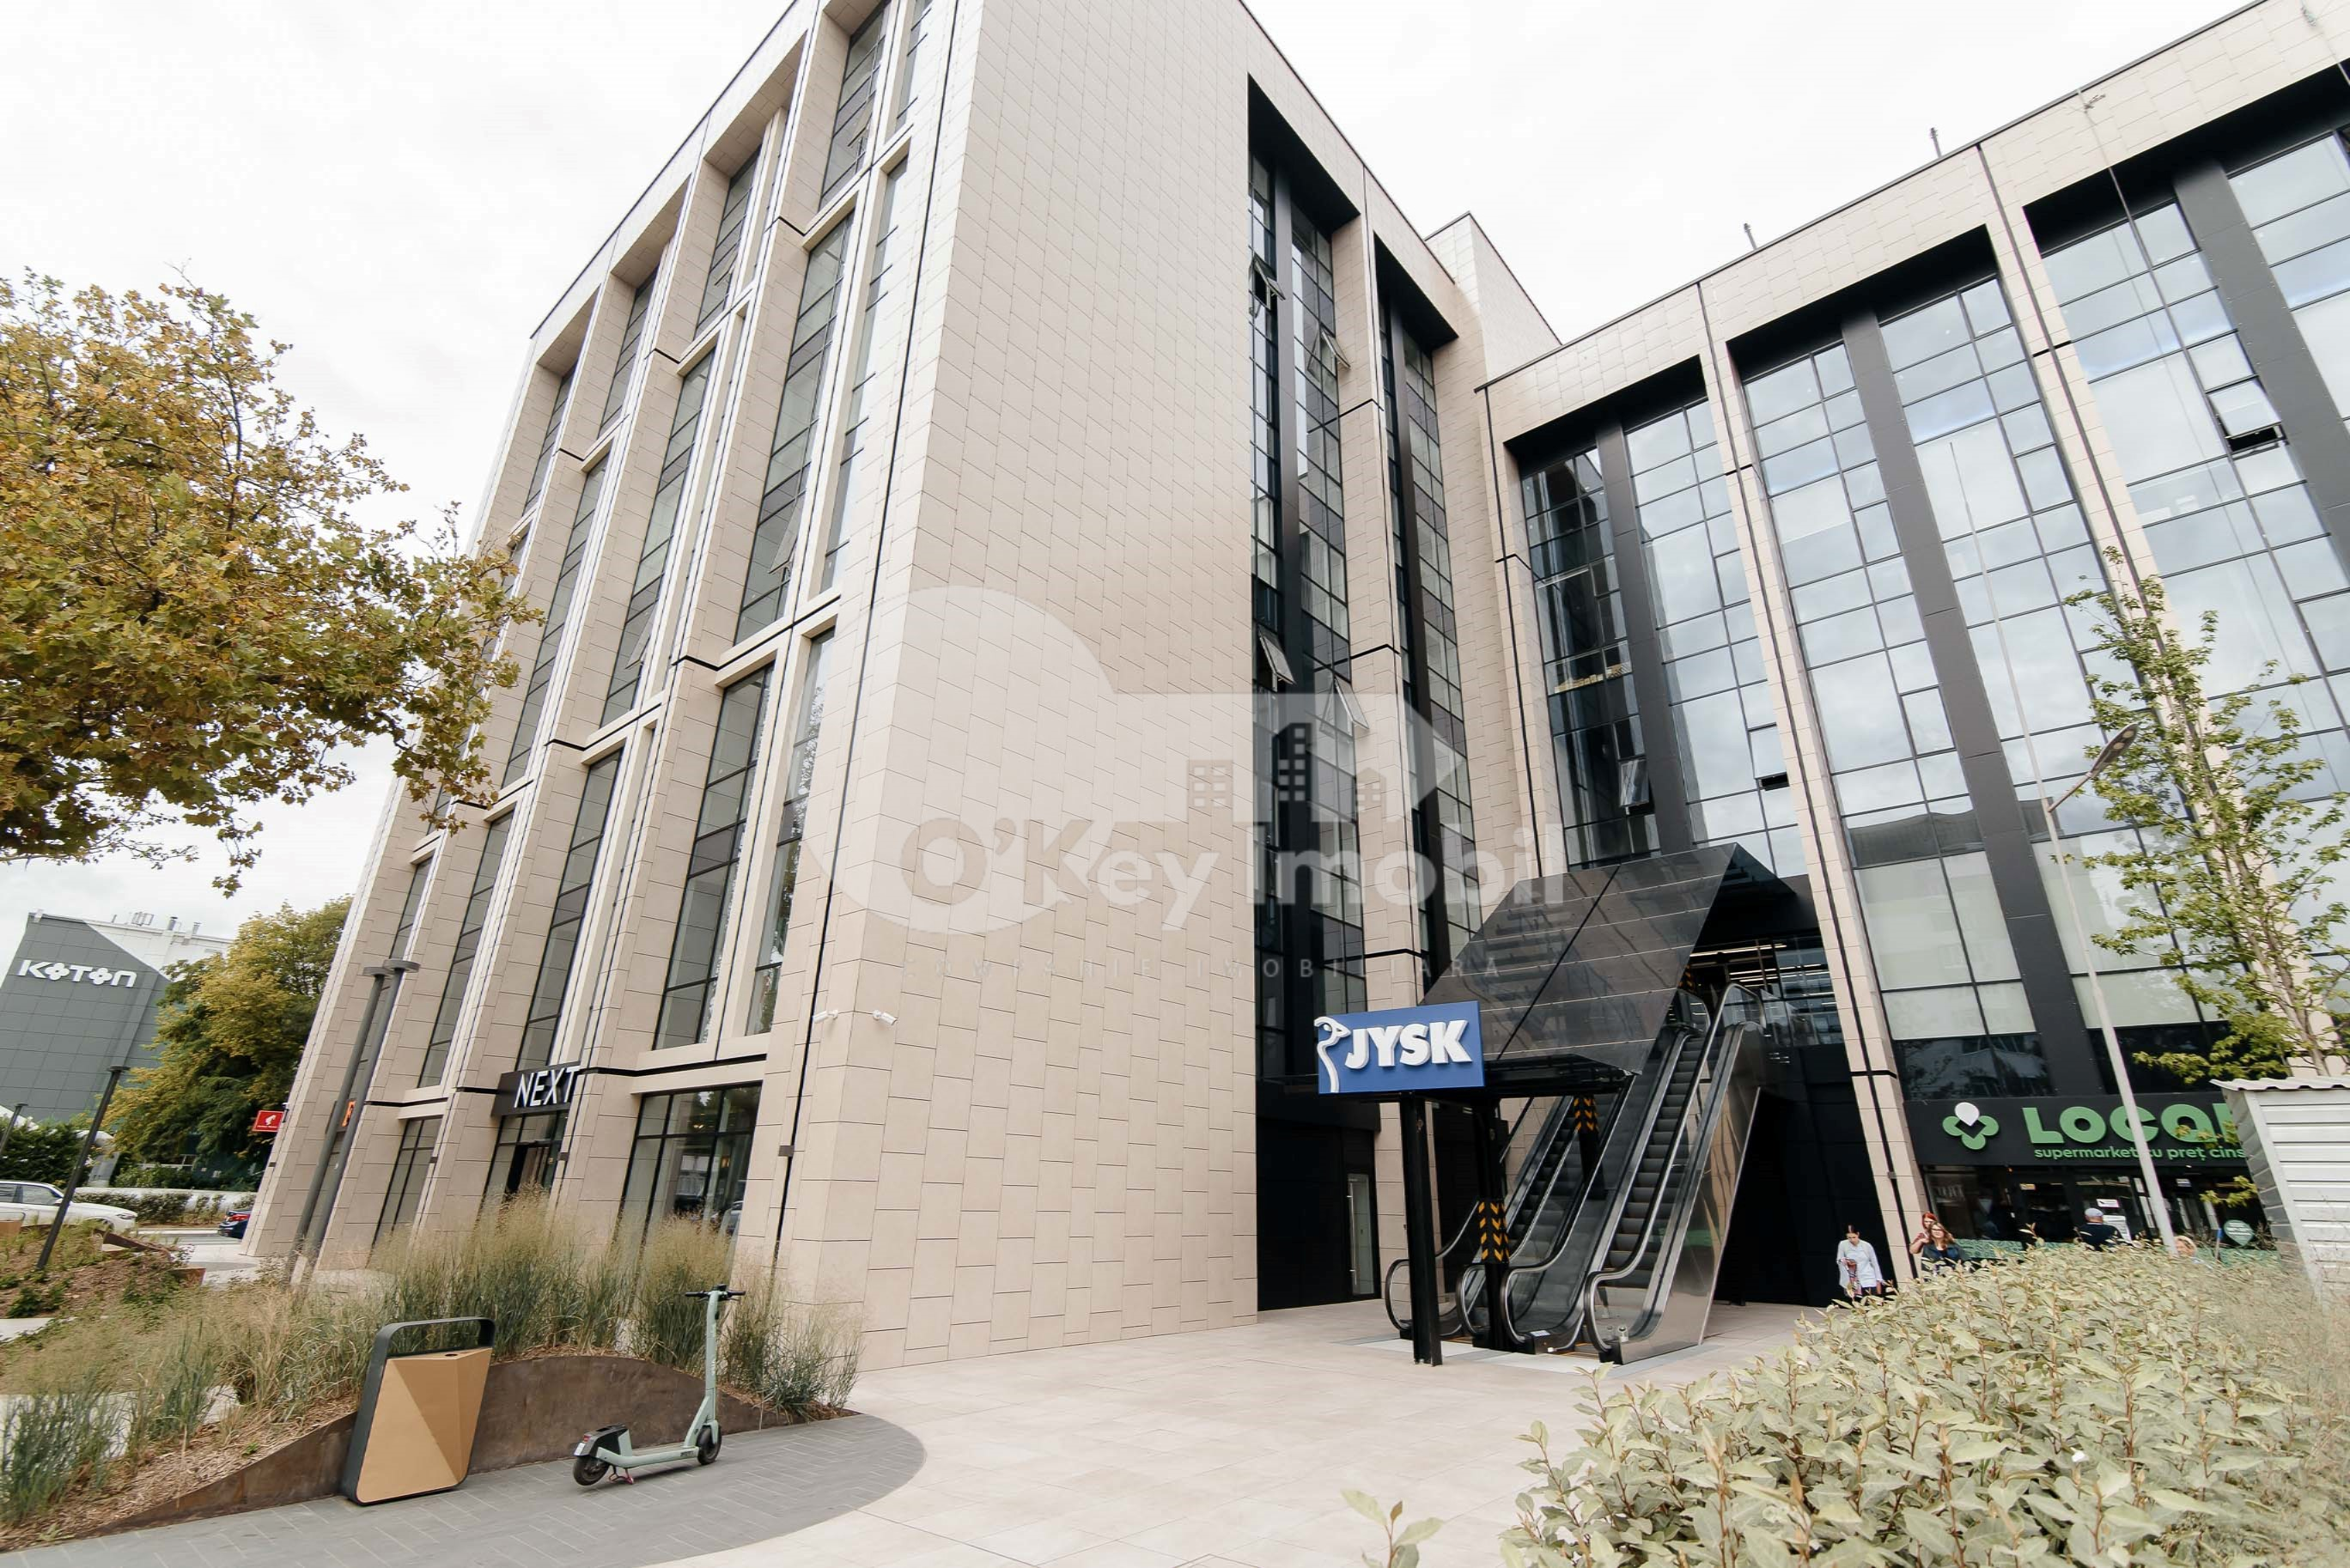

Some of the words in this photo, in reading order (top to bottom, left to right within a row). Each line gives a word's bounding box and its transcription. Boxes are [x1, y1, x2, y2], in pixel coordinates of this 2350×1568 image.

[17, 959, 137, 988] KOTON
[1344, 1019, 1473, 1070] JYSK
[514, 1065, 581, 1109] NEXT
[2034, 1146, 2140, 1160] supermarket
[2209, 1146, 2248, 1158] cins
